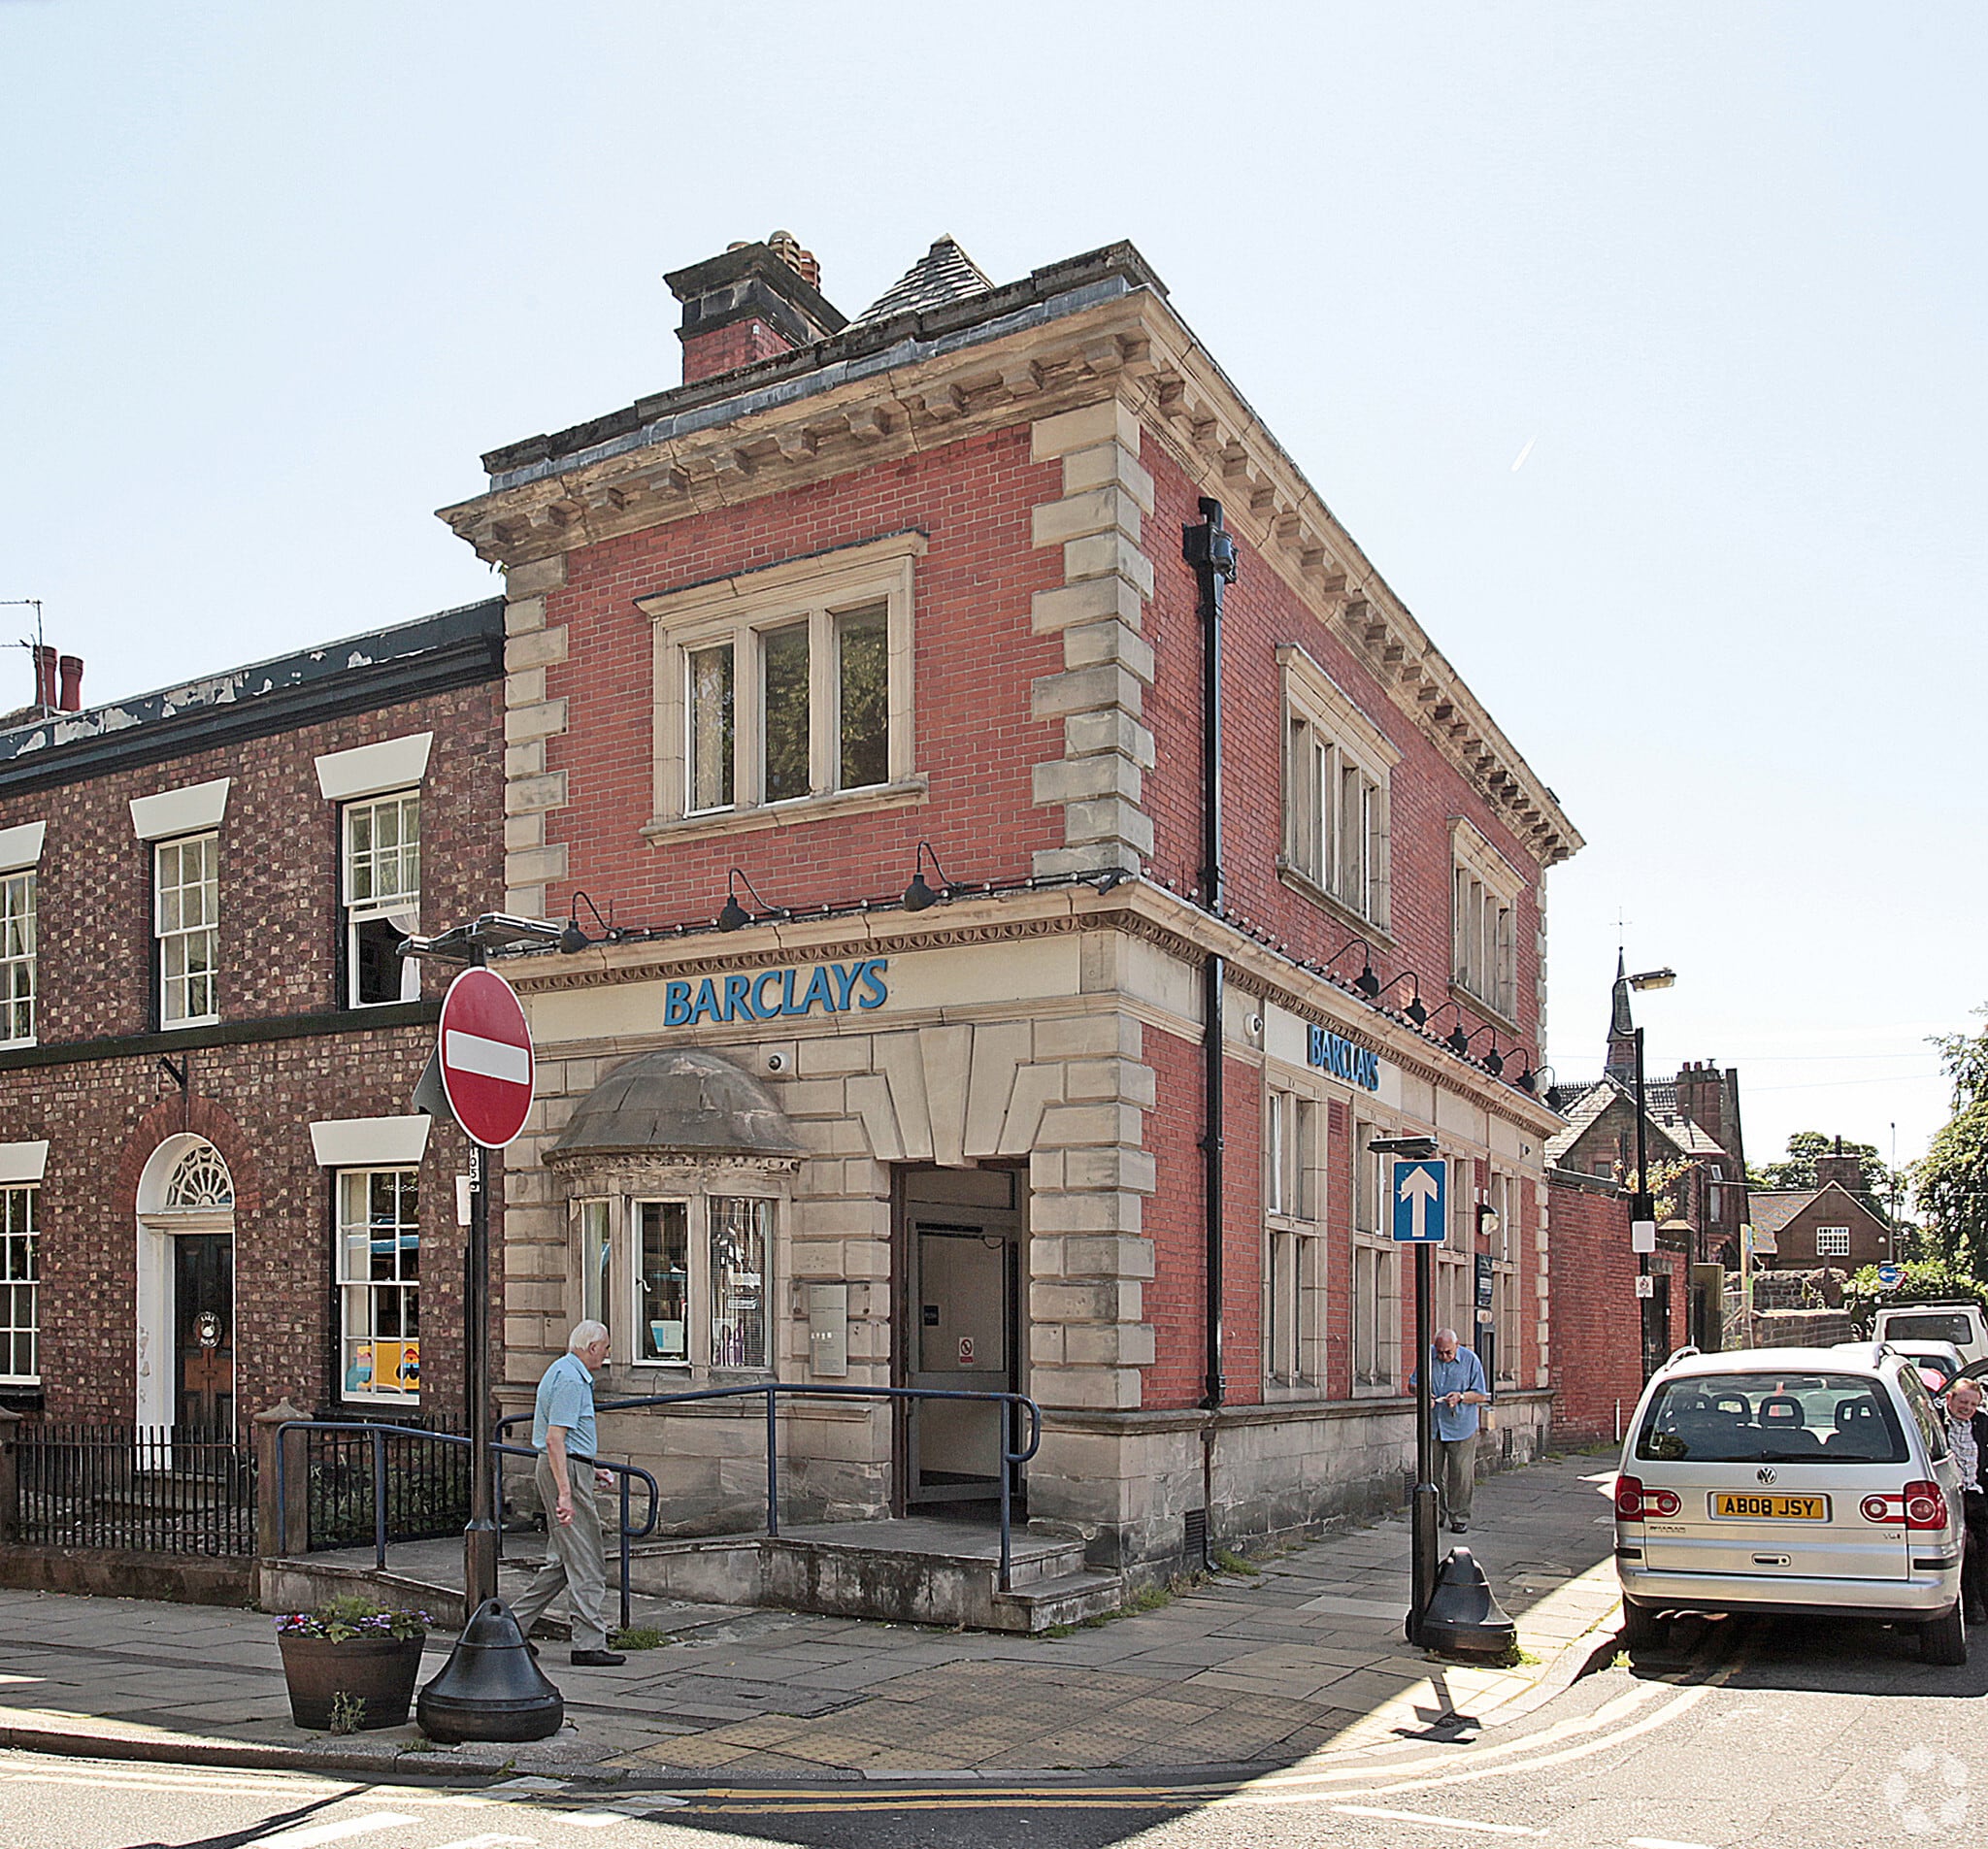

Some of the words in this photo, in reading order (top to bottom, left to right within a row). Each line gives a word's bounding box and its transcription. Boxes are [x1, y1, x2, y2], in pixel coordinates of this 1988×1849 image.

[664, 959, 888, 1026] BARCLAYS
[1307, 1024, 1379, 1091] BARCLAYS
[1725, 1497, 1773, 1514] AB08
[1778, 1500, 1814, 1516] JSY
